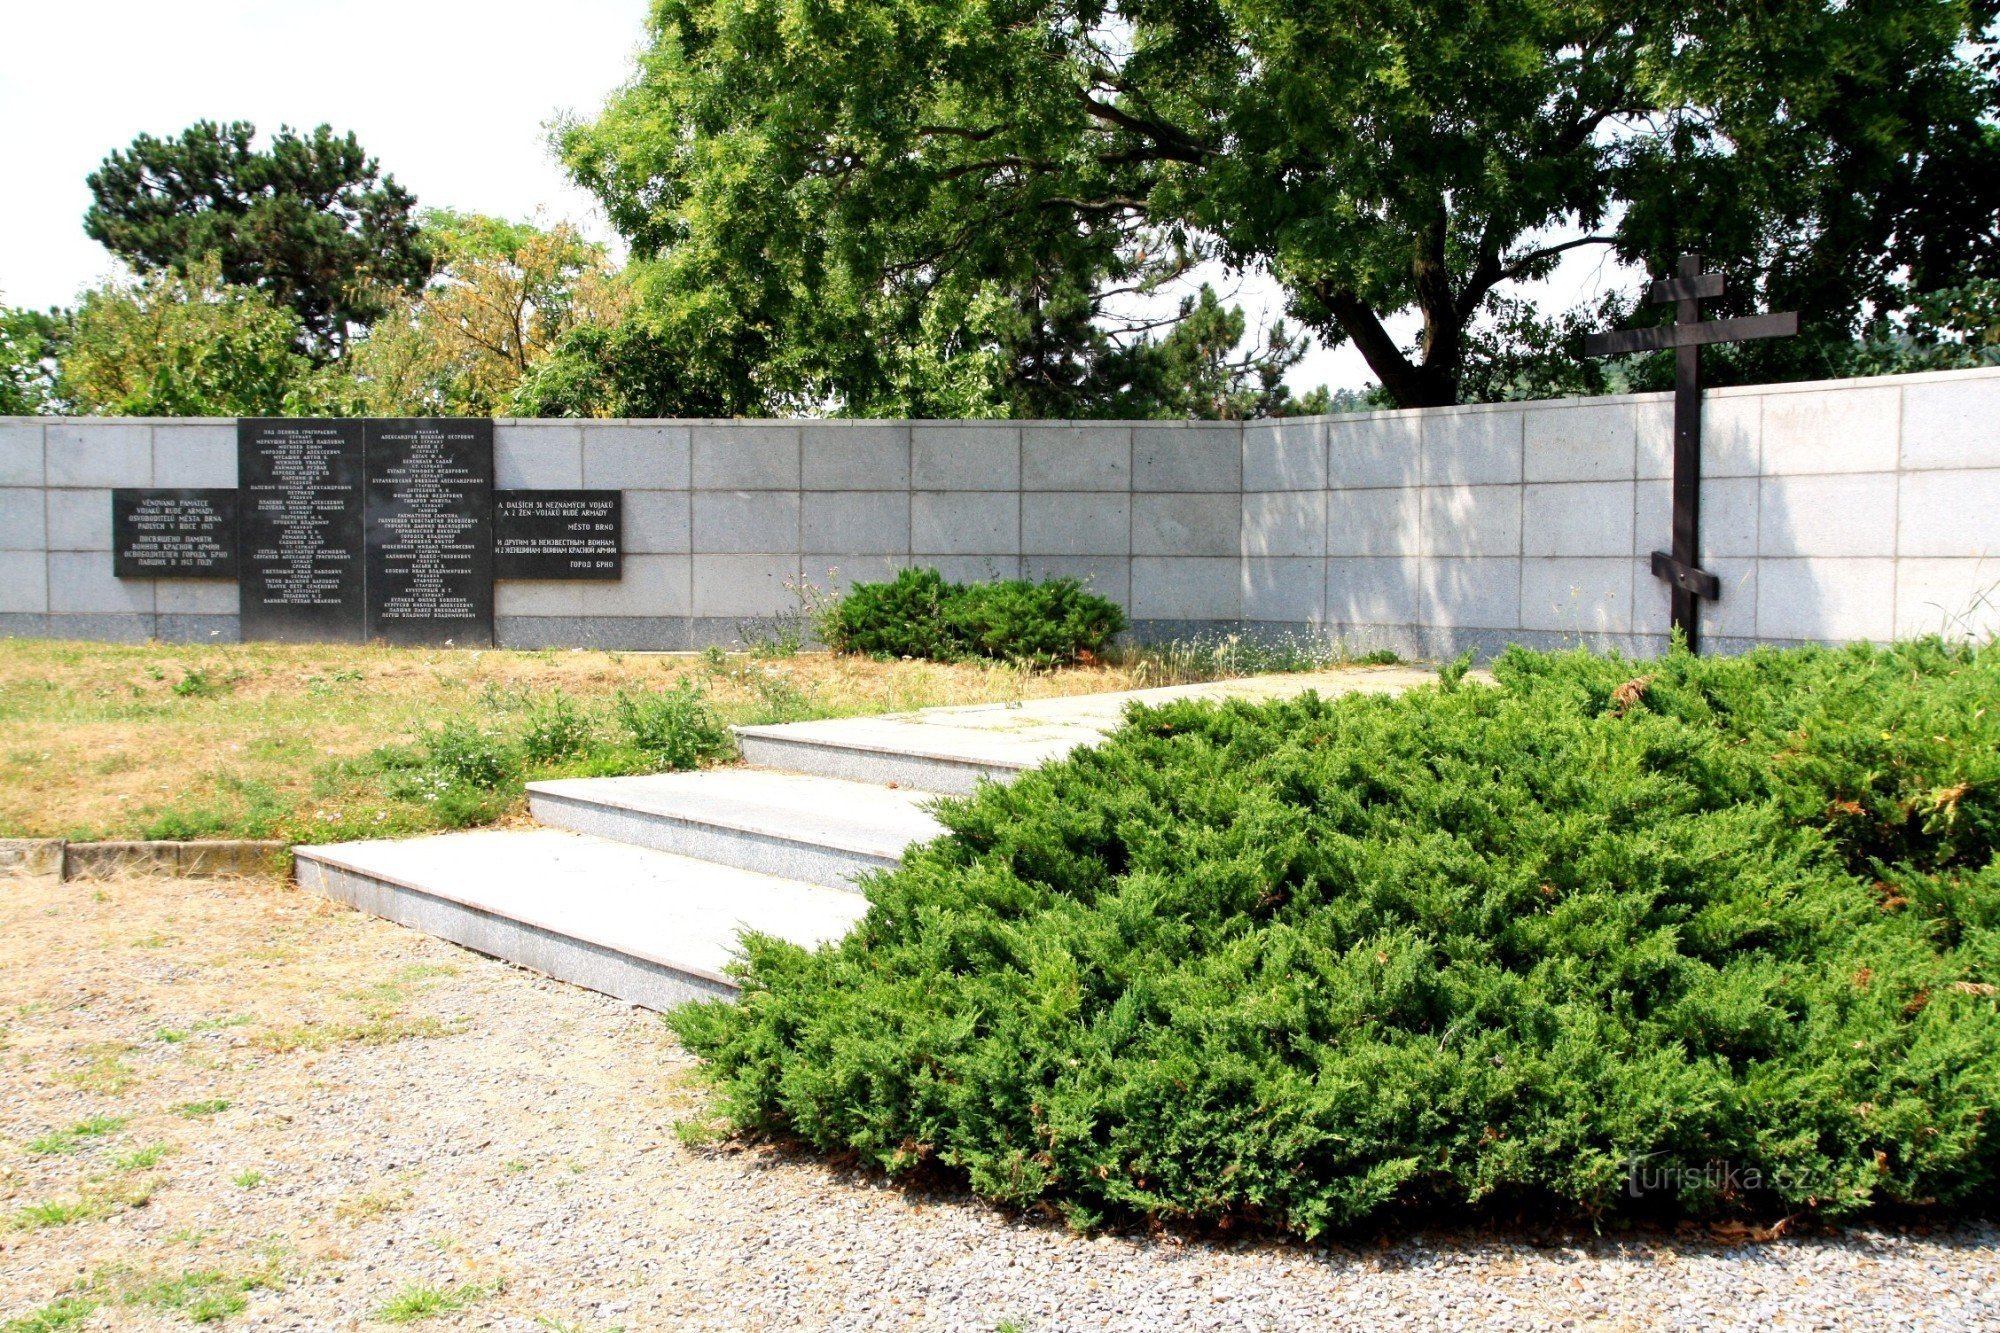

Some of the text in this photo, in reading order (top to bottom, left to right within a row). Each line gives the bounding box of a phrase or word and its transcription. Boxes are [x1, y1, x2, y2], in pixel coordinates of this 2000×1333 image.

[497, 500, 504, 508] A
[506, 500, 534, 508] DALŠÍCH
[545, 500, 586, 508] NEZNÁMÝCH
[589, 500, 614, 508] VOJÁKŮ
[503, 508, 608, 516] A 2 ŽEN-VOJÁKŮ RUDÉ ARMÁDY
[567, 522, 614, 531] MĚSTO BRNO
[494, 546, 500, 554] И
[500, 546, 504, 554] 2
[568, 546, 595, 554] КРАСНОЙ
[596, 546, 617, 554] АРМИИ
